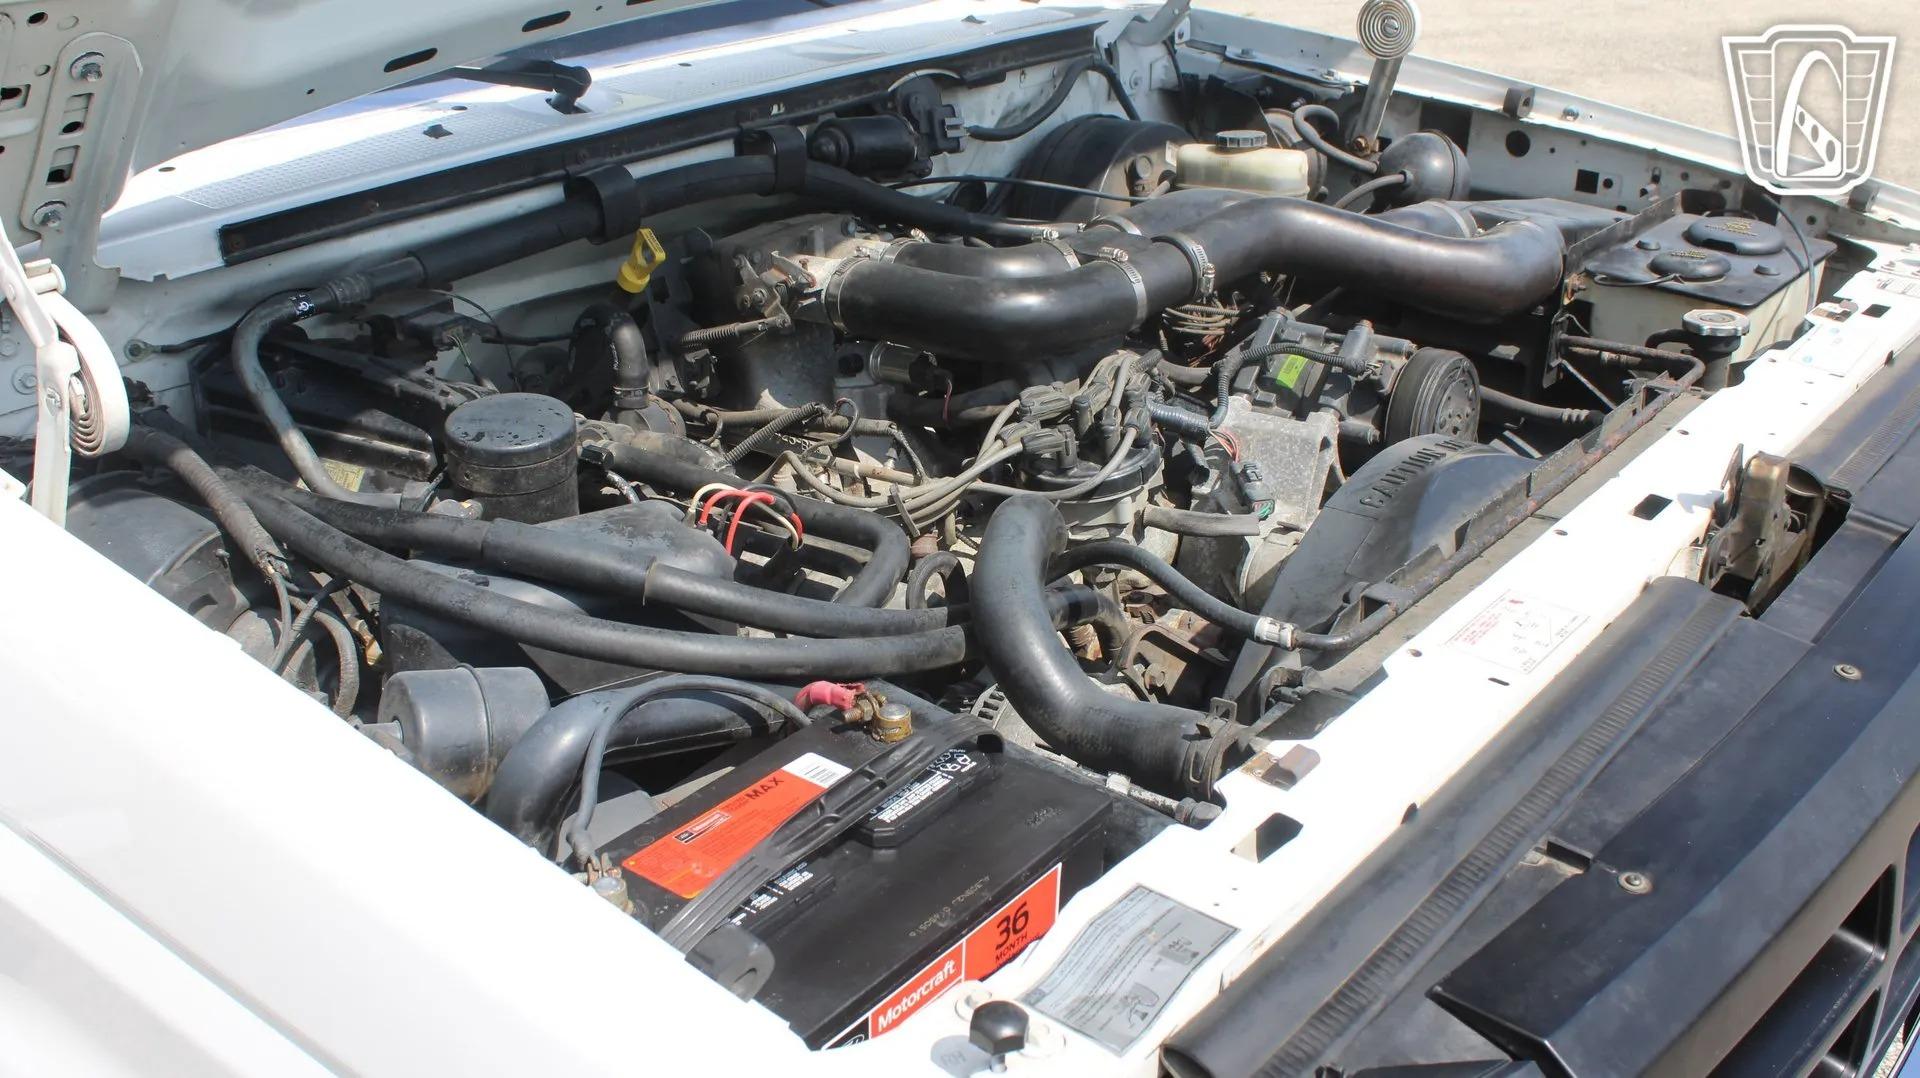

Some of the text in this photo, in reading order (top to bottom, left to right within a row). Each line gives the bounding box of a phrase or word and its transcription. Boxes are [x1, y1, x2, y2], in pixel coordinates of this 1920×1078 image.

[1359, 447, 1447, 509] CAUTION
[745, 776, 785, 800] MAX
[995, 901, 1029, 950] 36
[995, 934, 1028, 962] MONTH
[878, 959, 956, 1032] Motorcraft
